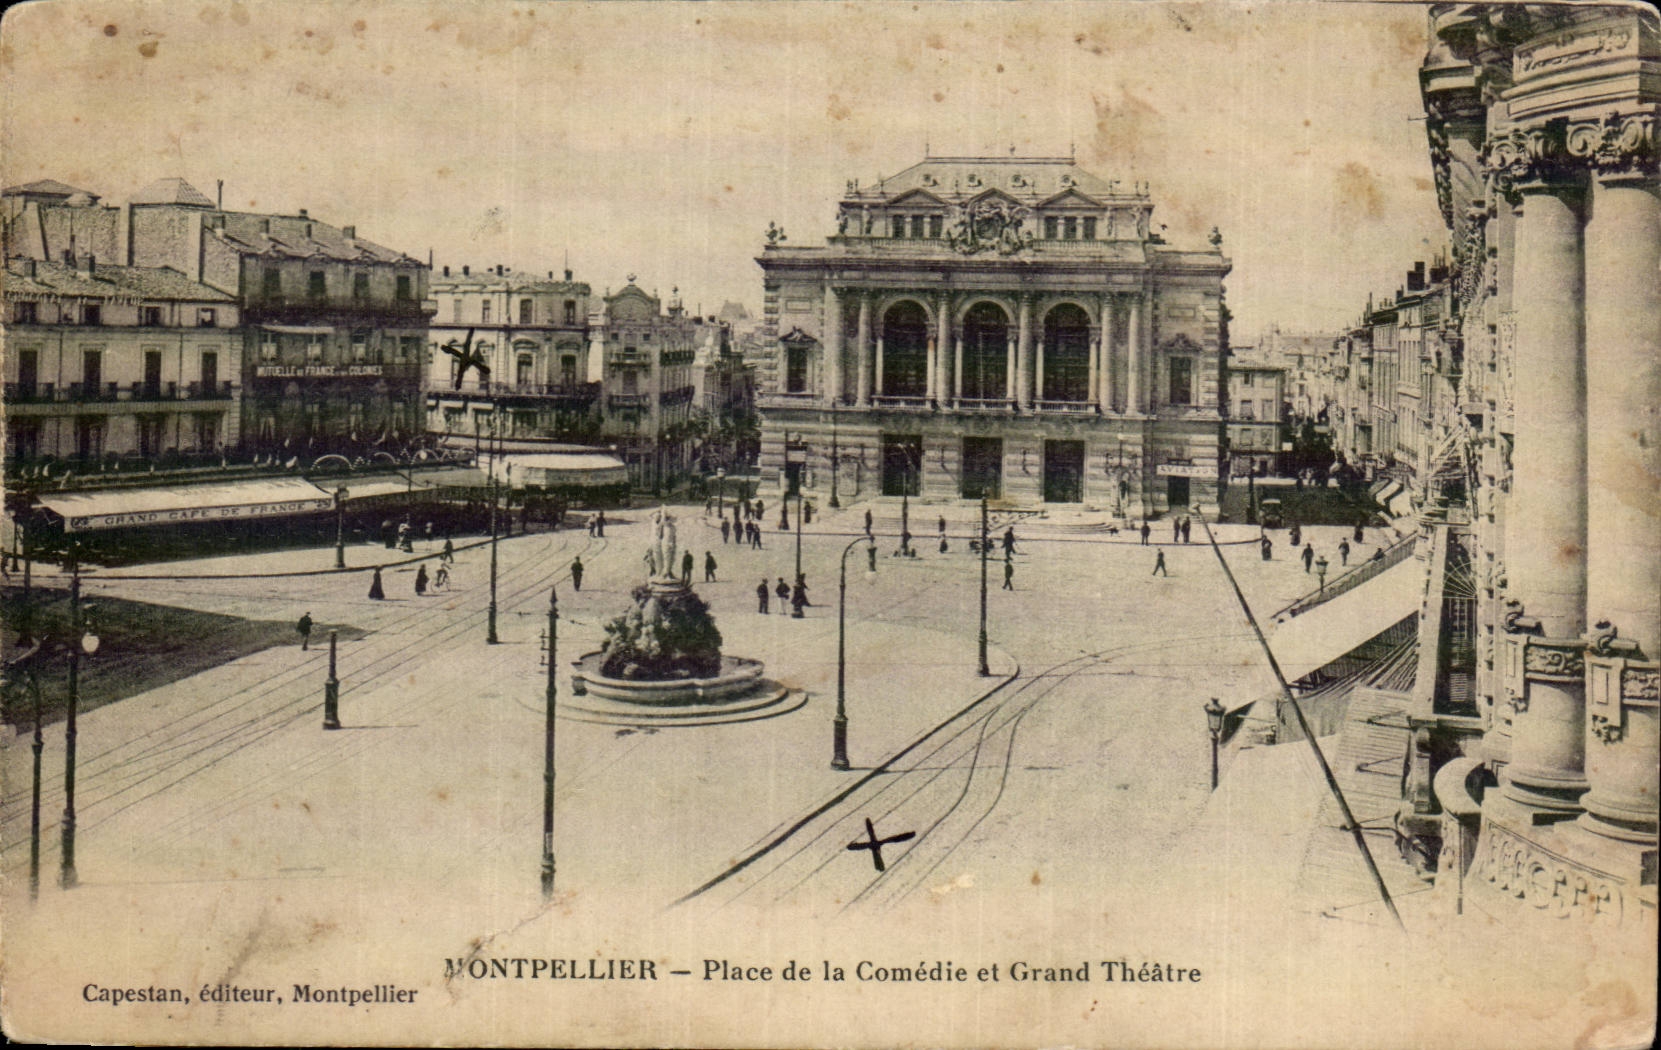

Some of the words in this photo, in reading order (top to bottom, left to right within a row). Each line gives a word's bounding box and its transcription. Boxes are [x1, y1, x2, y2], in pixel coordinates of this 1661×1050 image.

[257, 366, 296, 377] MUTUELLE
[304, 366, 336, 377] FRANCE
[349, 365, 383, 376] COLONIES
[104, 513, 158, 525] GRAND
[221, 507, 240, 516] DE
[250, 502, 305, 514] FRANCE
